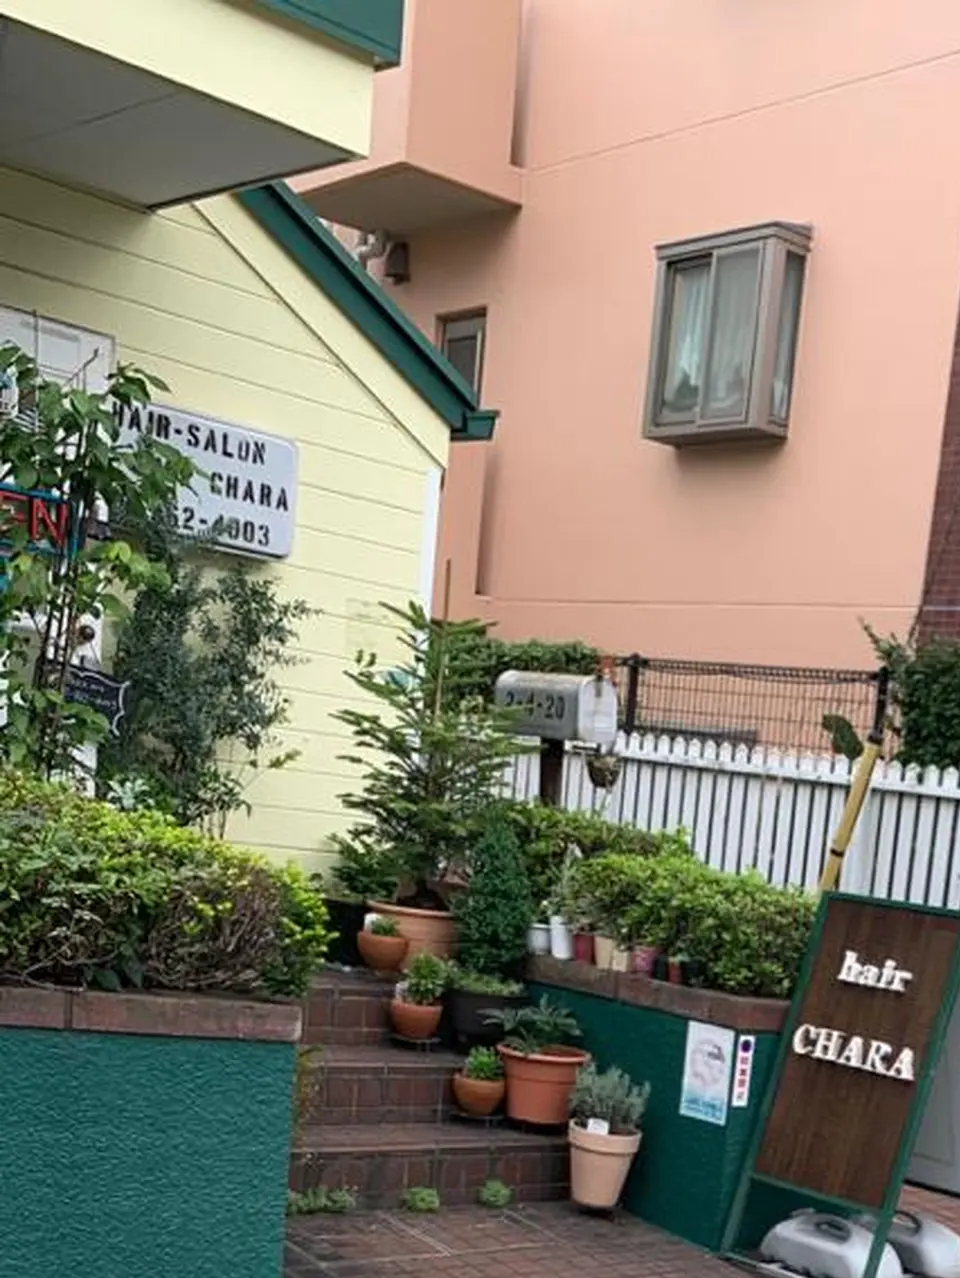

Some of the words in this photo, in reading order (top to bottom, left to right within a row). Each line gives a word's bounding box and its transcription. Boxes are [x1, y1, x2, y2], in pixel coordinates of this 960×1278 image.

[111, 401, 267, 466] HAIR-SALON
[209, 471, 289, 512] CHARA
[837, 950, 914, 993] hair
[792, 1023, 916, 1082] CHARA
